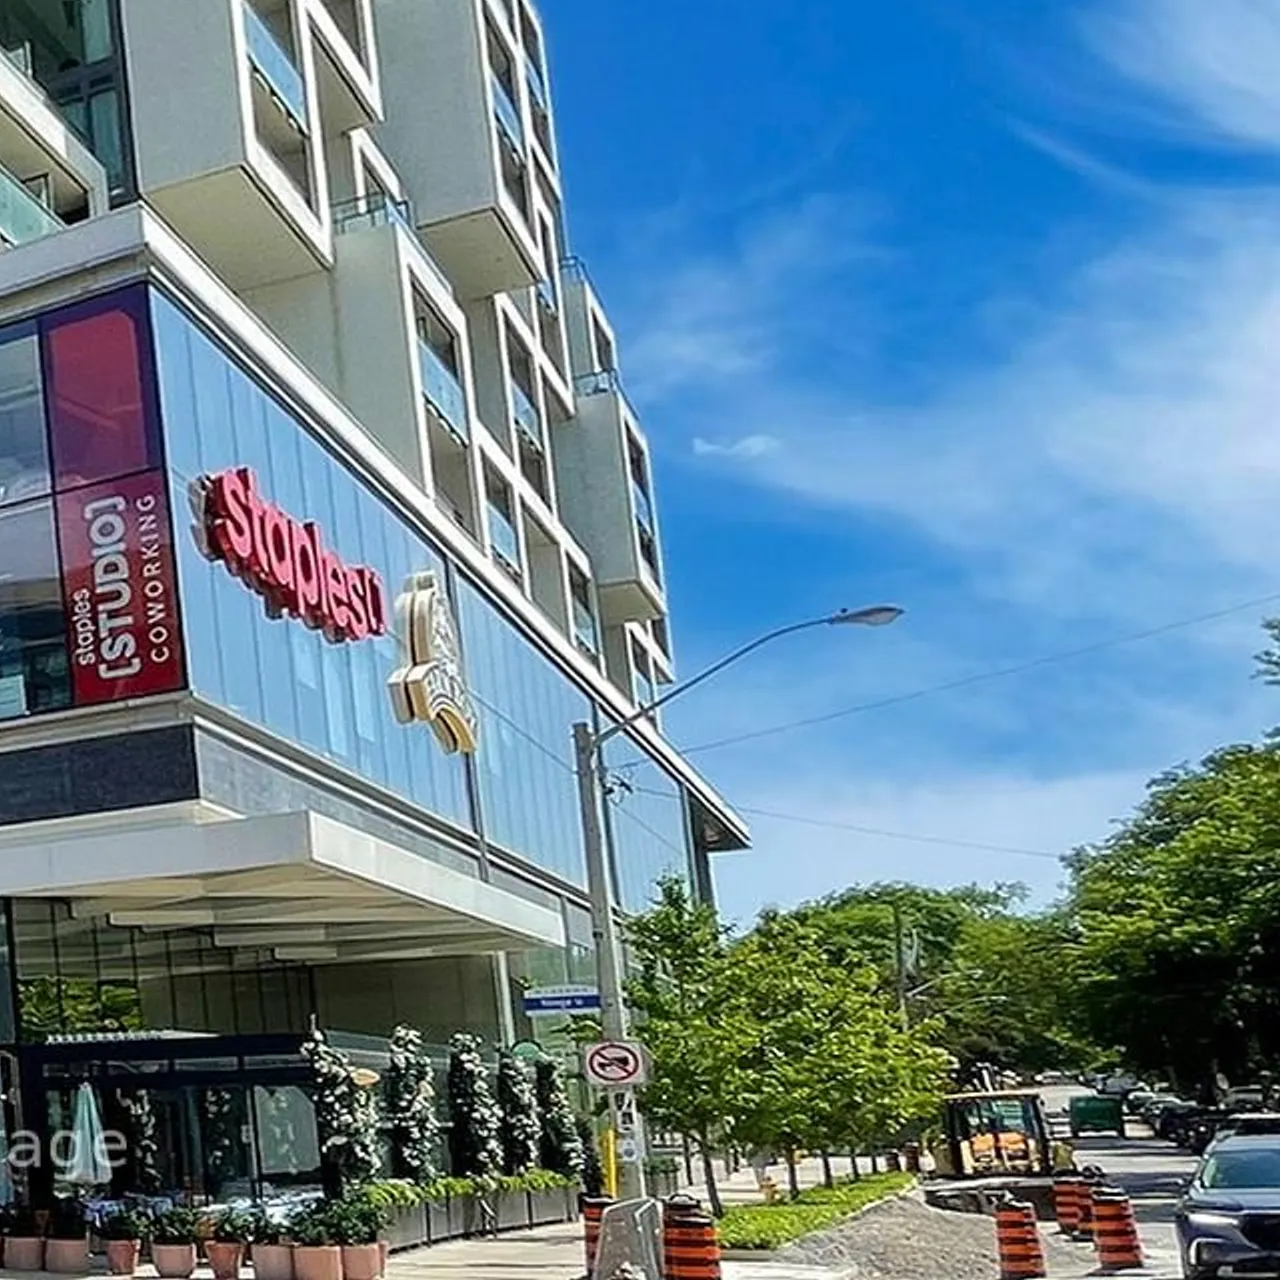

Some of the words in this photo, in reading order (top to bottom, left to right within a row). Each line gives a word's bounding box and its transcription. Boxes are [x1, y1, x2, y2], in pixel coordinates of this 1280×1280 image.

[73, 587, 97, 666] staples
[136, 494, 170, 663] COWORKING
[220, 467, 371, 642] staples
